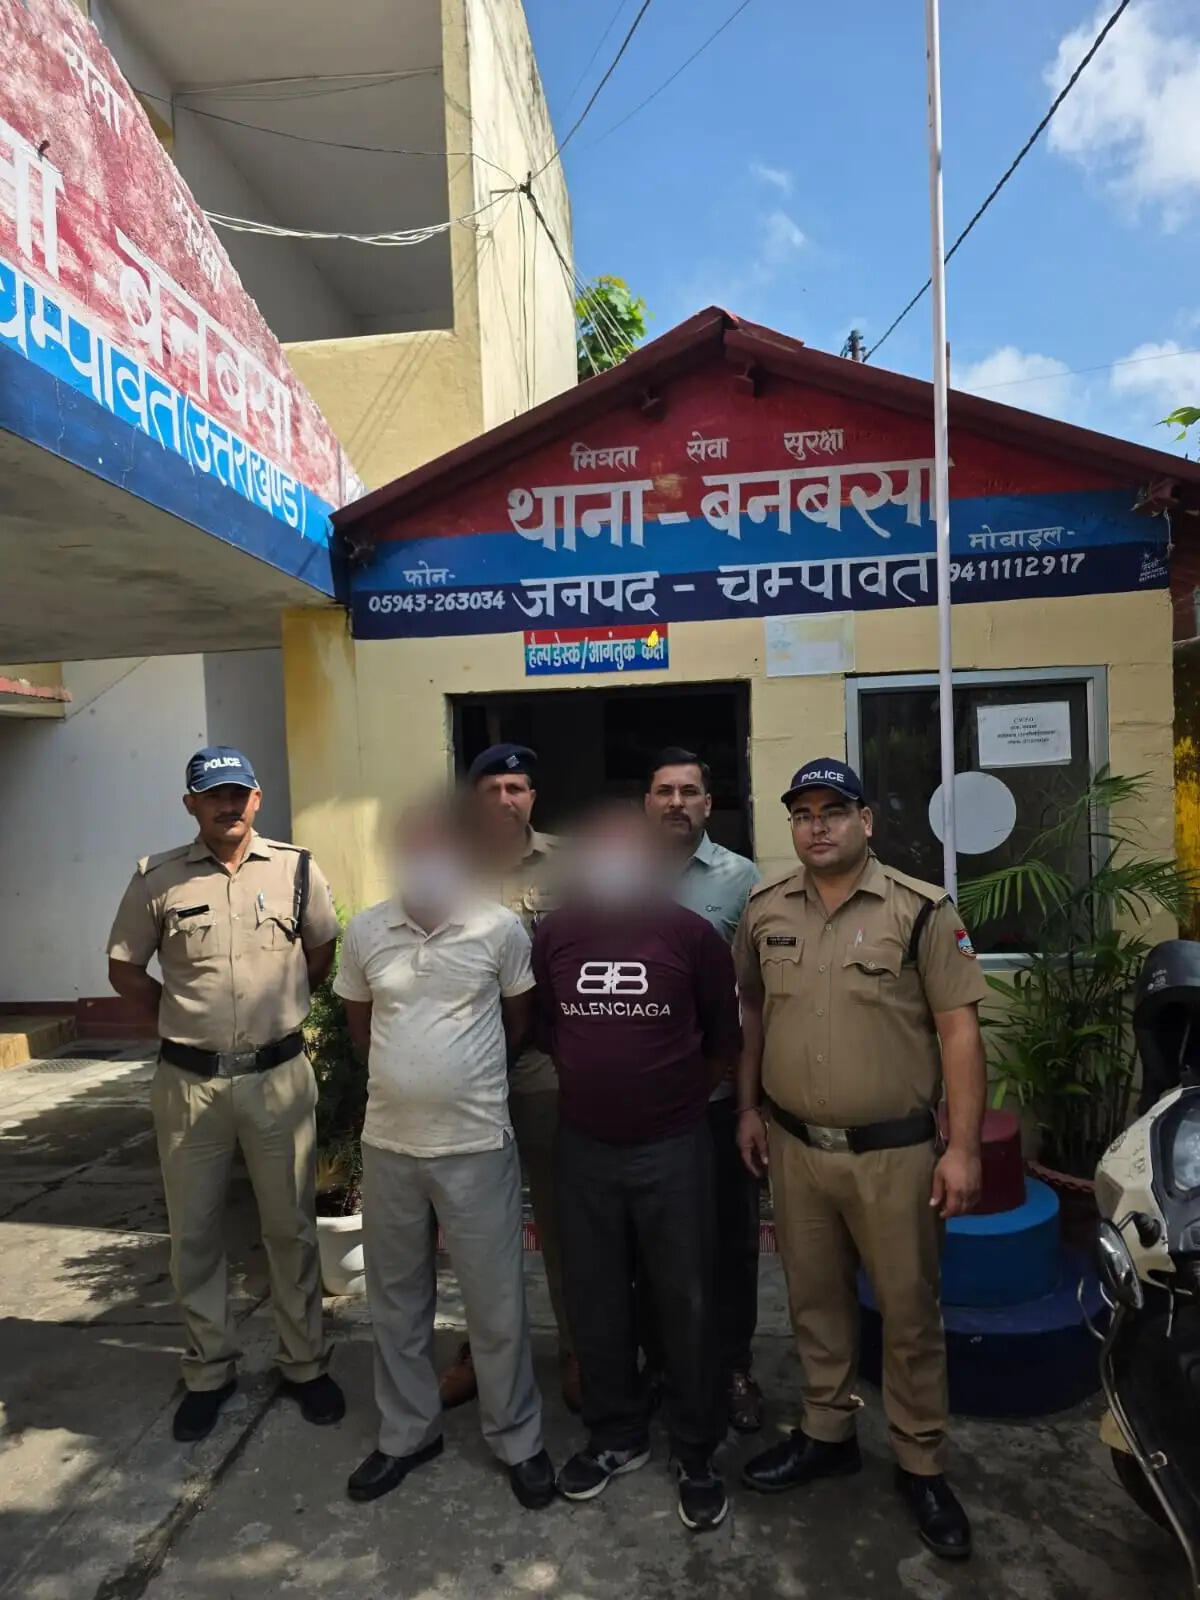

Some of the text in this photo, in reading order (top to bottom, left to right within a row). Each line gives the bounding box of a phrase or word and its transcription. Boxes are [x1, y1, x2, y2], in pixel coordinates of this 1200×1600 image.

[686, 430, 730, 464] सेवा
[784, 428, 844, 461] सुरक्षा
[507, 479, 654, 552] थाना
[949, 552, 1086, 582] 9411112917
[511, 570, 661, 618] जनपद
[716, 551, 938, 604] चम्पावत
[368, 590, 506, 613] 05943-263034
[203, 756, 242, 772] POLICE
[801, 769, 845, 783] POLICE
[560, 1002, 671, 1016] BALENCIAGA
